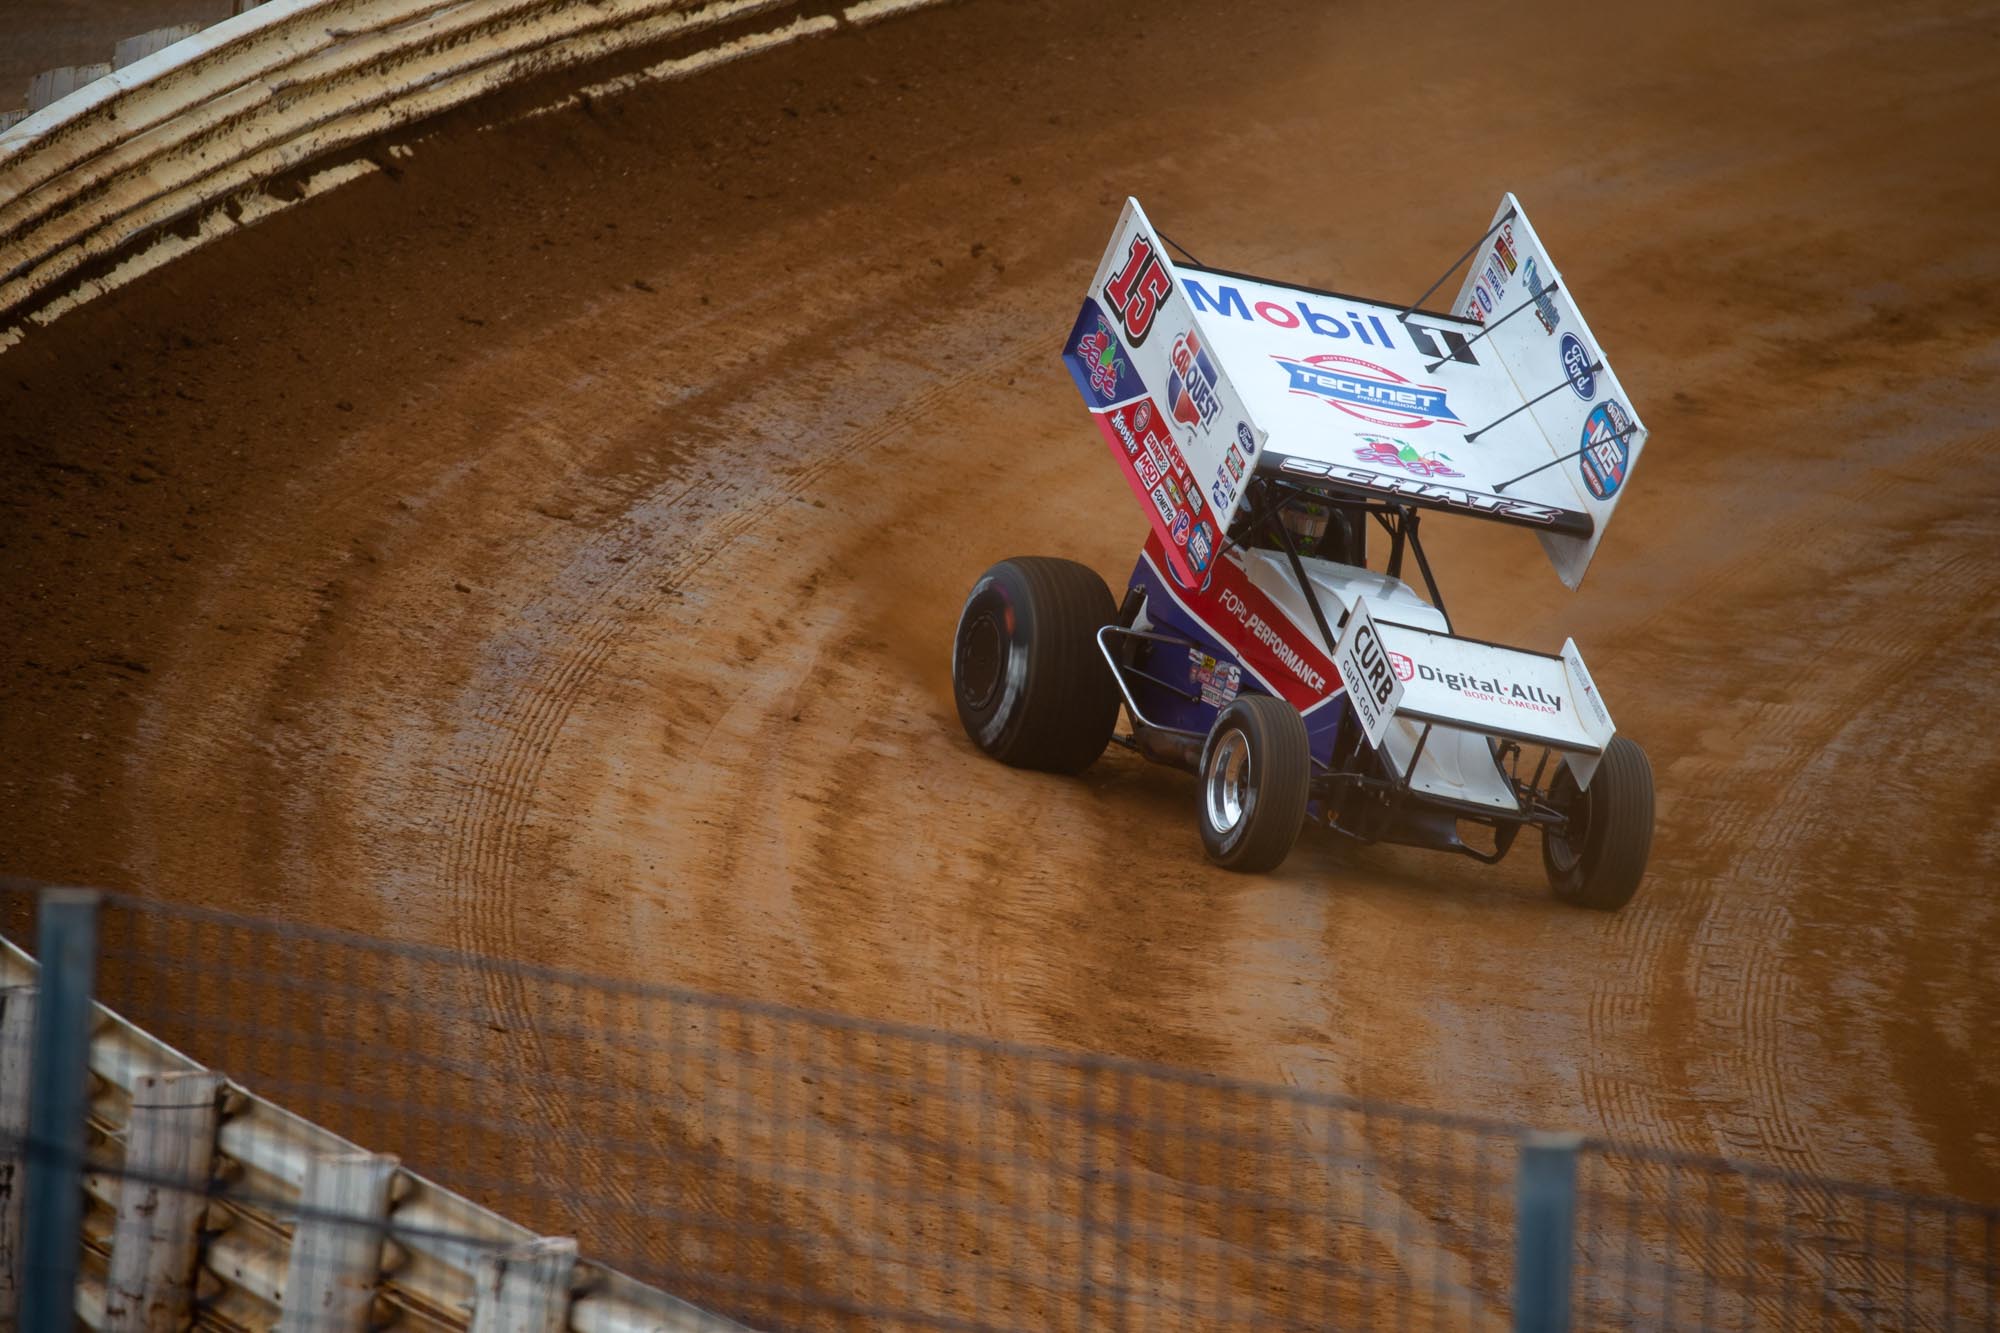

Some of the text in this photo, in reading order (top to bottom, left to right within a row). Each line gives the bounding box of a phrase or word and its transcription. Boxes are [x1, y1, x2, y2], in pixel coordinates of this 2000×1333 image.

[1105, 234, 1172, 344] 15
[1485, 267, 1505, 300] MAHLE
[1181, 278, 1396, 349] Mobil
[1564, 343, 1591, 392] Ford
[1357, 394, 1430, 413] PROFESSIONAL
[1112, 411, 1138, 455] Hoosier
[1146, 434, 1164, 463] COMP
[1165, 438, 1186, 472] ARP
[1240, 426, 1253, 450] Ford
[1589, 421, 1623, 475] NOS
[1138, 455, 1158, 484] MSD
[1281, 457, 1562, 522] SCHATZ
[1154, 489, 1174, 521] COMETIC
[1244, 613, 1327, 695] PERFORMANCE
[1354, 625, 1394, 705] CURB
[1343, 660, 1376, 730] curb.com
[1464, 689, 1557, 715] BODY CAMERAS
